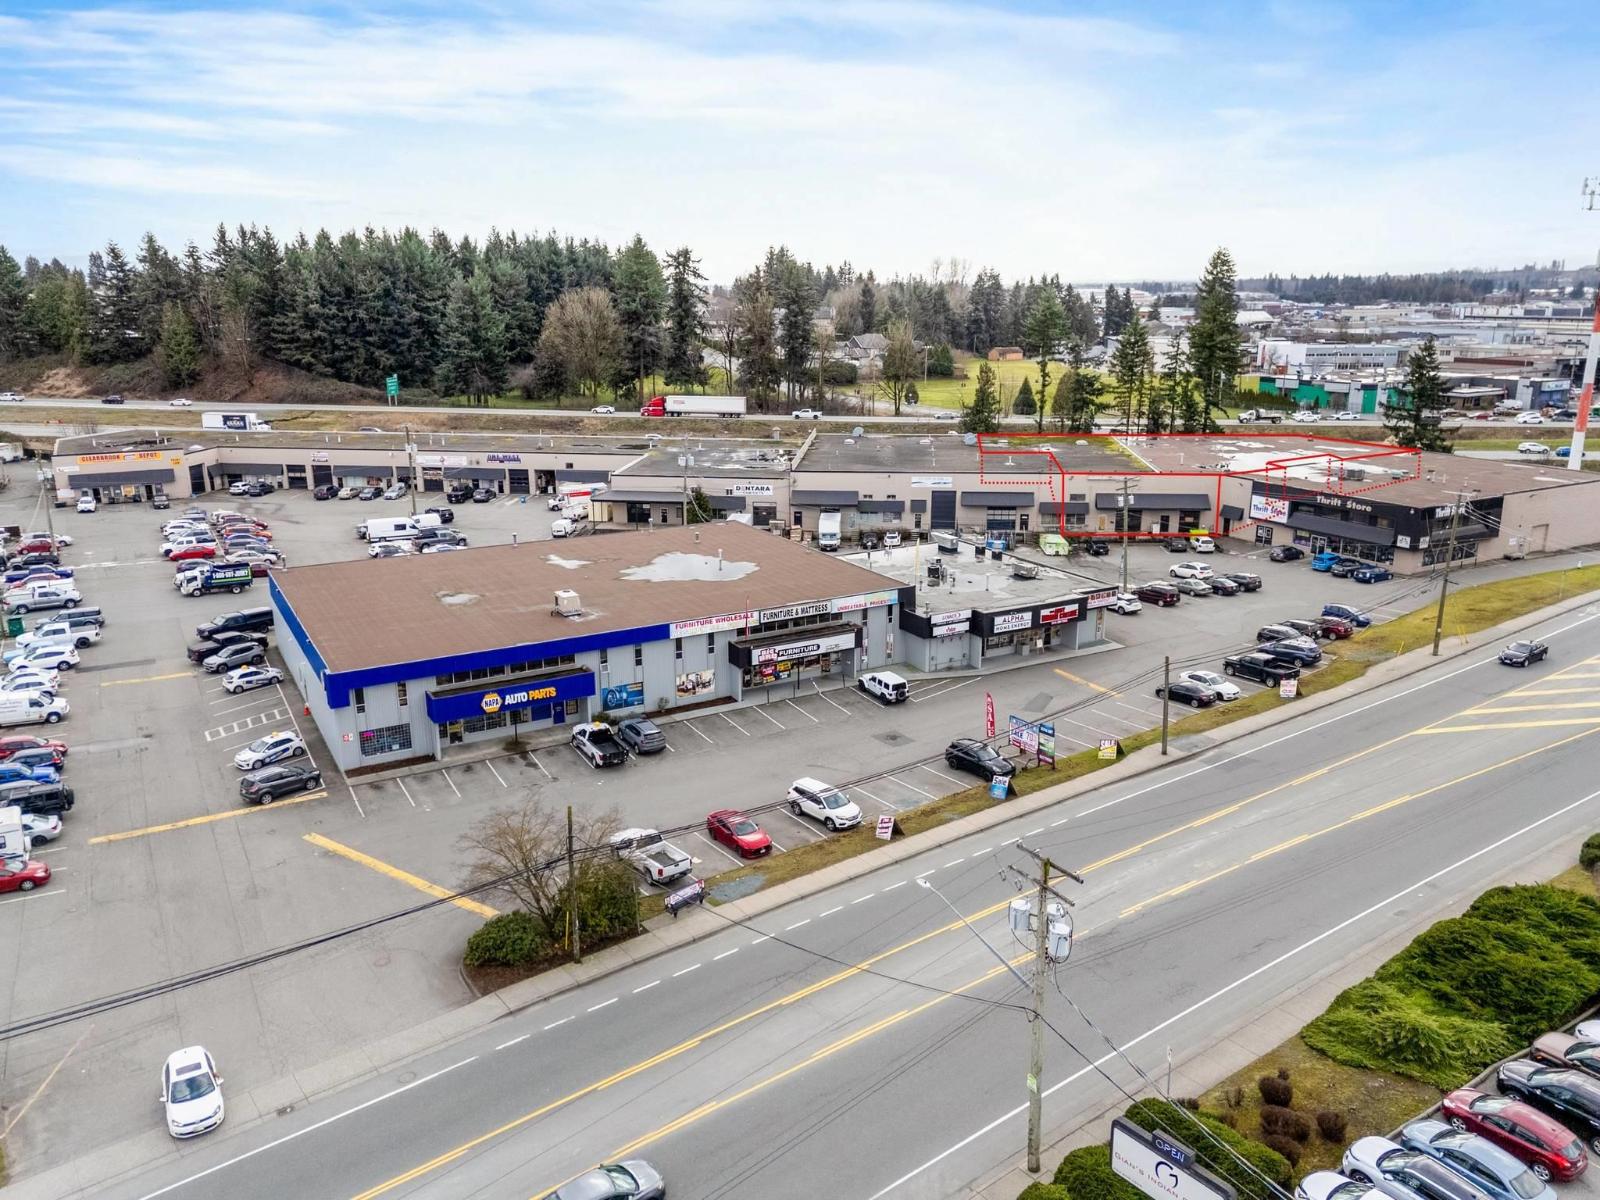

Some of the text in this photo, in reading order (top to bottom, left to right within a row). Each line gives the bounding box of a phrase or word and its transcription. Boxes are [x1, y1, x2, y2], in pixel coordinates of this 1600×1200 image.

[81, 454, 121, 462] CLEARBROOK
[1316, 495, 1373, 512] Thrift Store
[763, 603, 829, 621] FURNITURE & MATTRESS
[1002, 614, 1025, 624] ALPHA
[675, 612, 755, 630] FURNITURE WHOLESALE
[778, 644, 819, 656] FURNITURE
[484, 698, 500, 708] NAPA
[504, 687, 557, 706] AUTO PARTS
[987, 704, 995, 738] SALE
[1155, 1139, 1186, 1163] OPEN
